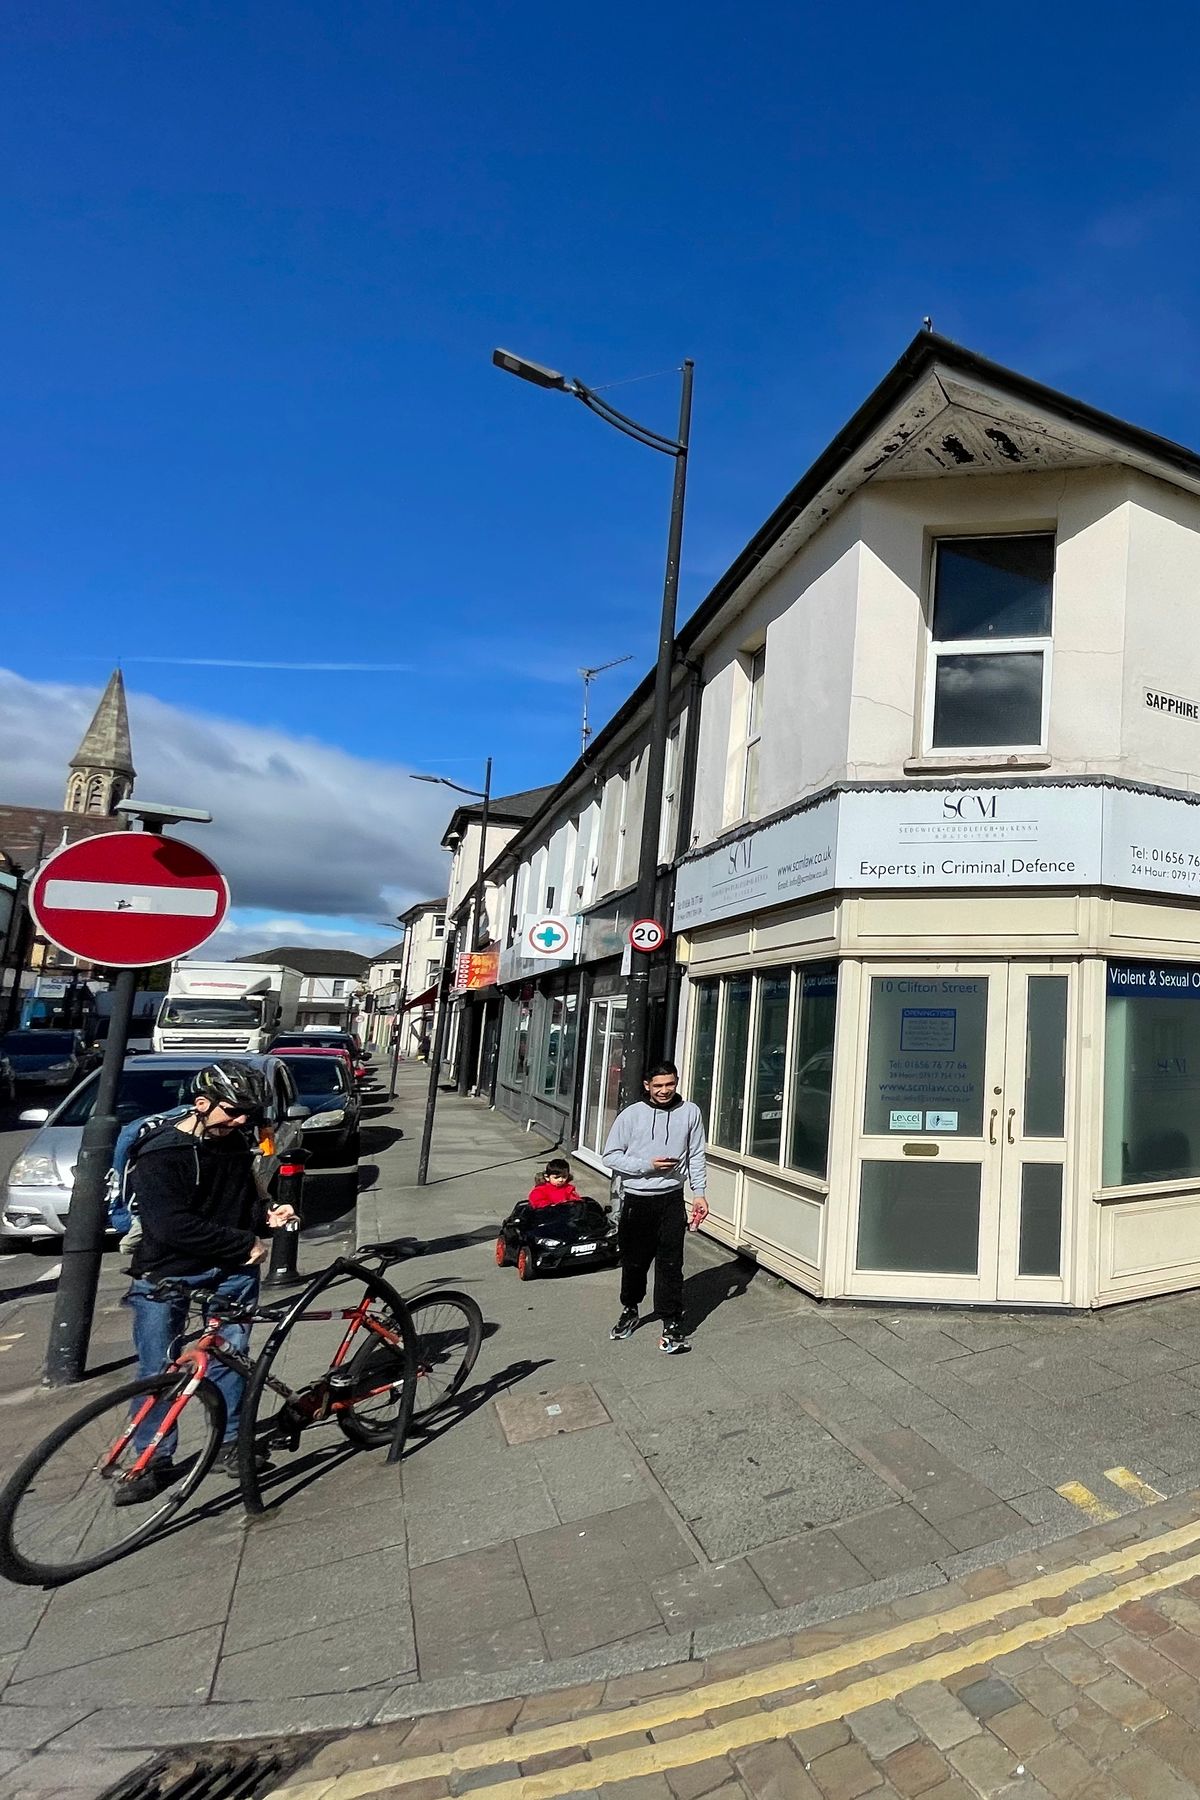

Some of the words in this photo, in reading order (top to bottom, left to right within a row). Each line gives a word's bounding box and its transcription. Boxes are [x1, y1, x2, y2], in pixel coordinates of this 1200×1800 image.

[1146, 692, 1198, 719] SAPPHIRE
[942, 795, 998, 819] SCM
[1130, 845, 1149, 860] Tel:
[1152, 849, 1184, 865] 01656
[1188, 854, 1200, 867] 76
[860, 861, 917, 879] Experts
[922, 861, 935, 875] in
[941, 860, 1006, 875] Criminal
[1011, 858, 1075, 873] Defence
[1131, 864, 1142, 874] 24
[1144, 866, 1169, 878] Hour:
[1171, 869, 1196, 881] 07917
[634, 928, 659, 942] 20
[880, 981, 894, 993] 10
[898, 981, 937, 993] Clifton
[942, 981, 978, 993] Street
[1109, 967, 1146, 985] Violent
[1149, 970, 1157, 986] &
[1159, 970, 1190, 987] Sexual
[879, 1082, 974, 1093] www.scmlaw.co.uk
